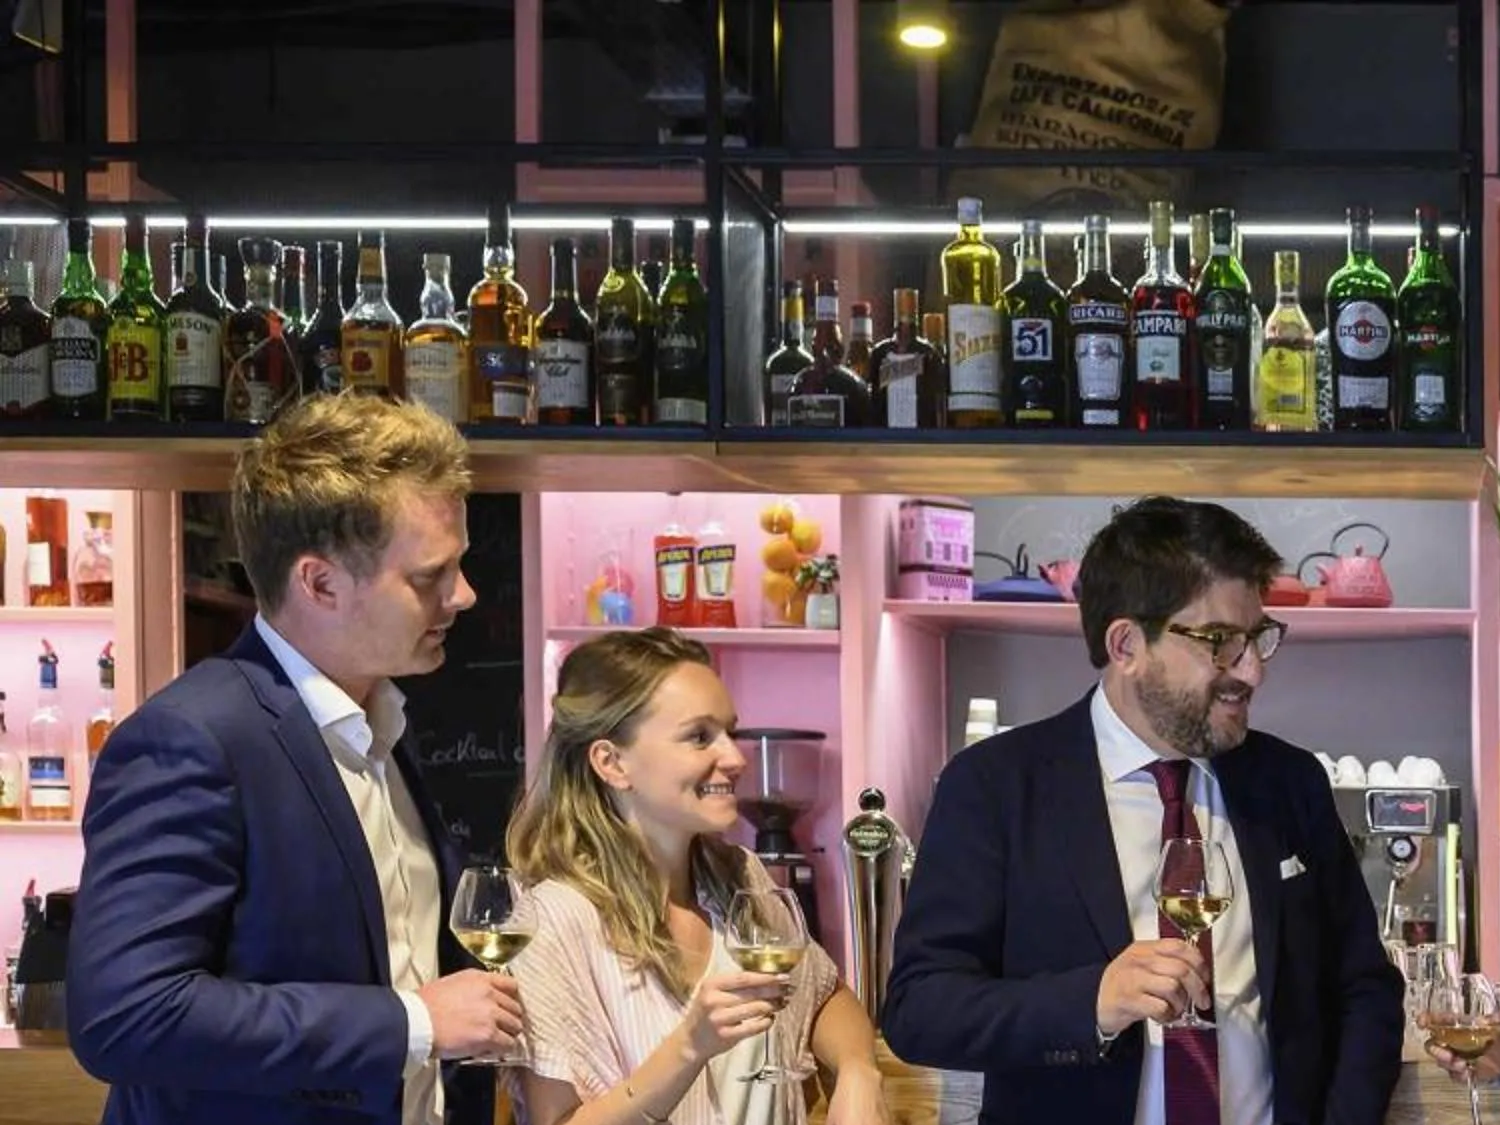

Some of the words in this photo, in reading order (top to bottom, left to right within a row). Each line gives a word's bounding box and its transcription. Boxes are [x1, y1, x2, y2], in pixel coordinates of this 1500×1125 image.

[1072, 306, 1124, 322] RICARD
[1131, 316, 1186, 334] CAMPARI
[1340, 326, 1388, 339] MARTINI
[1016, 326, 1048, 358] 51
